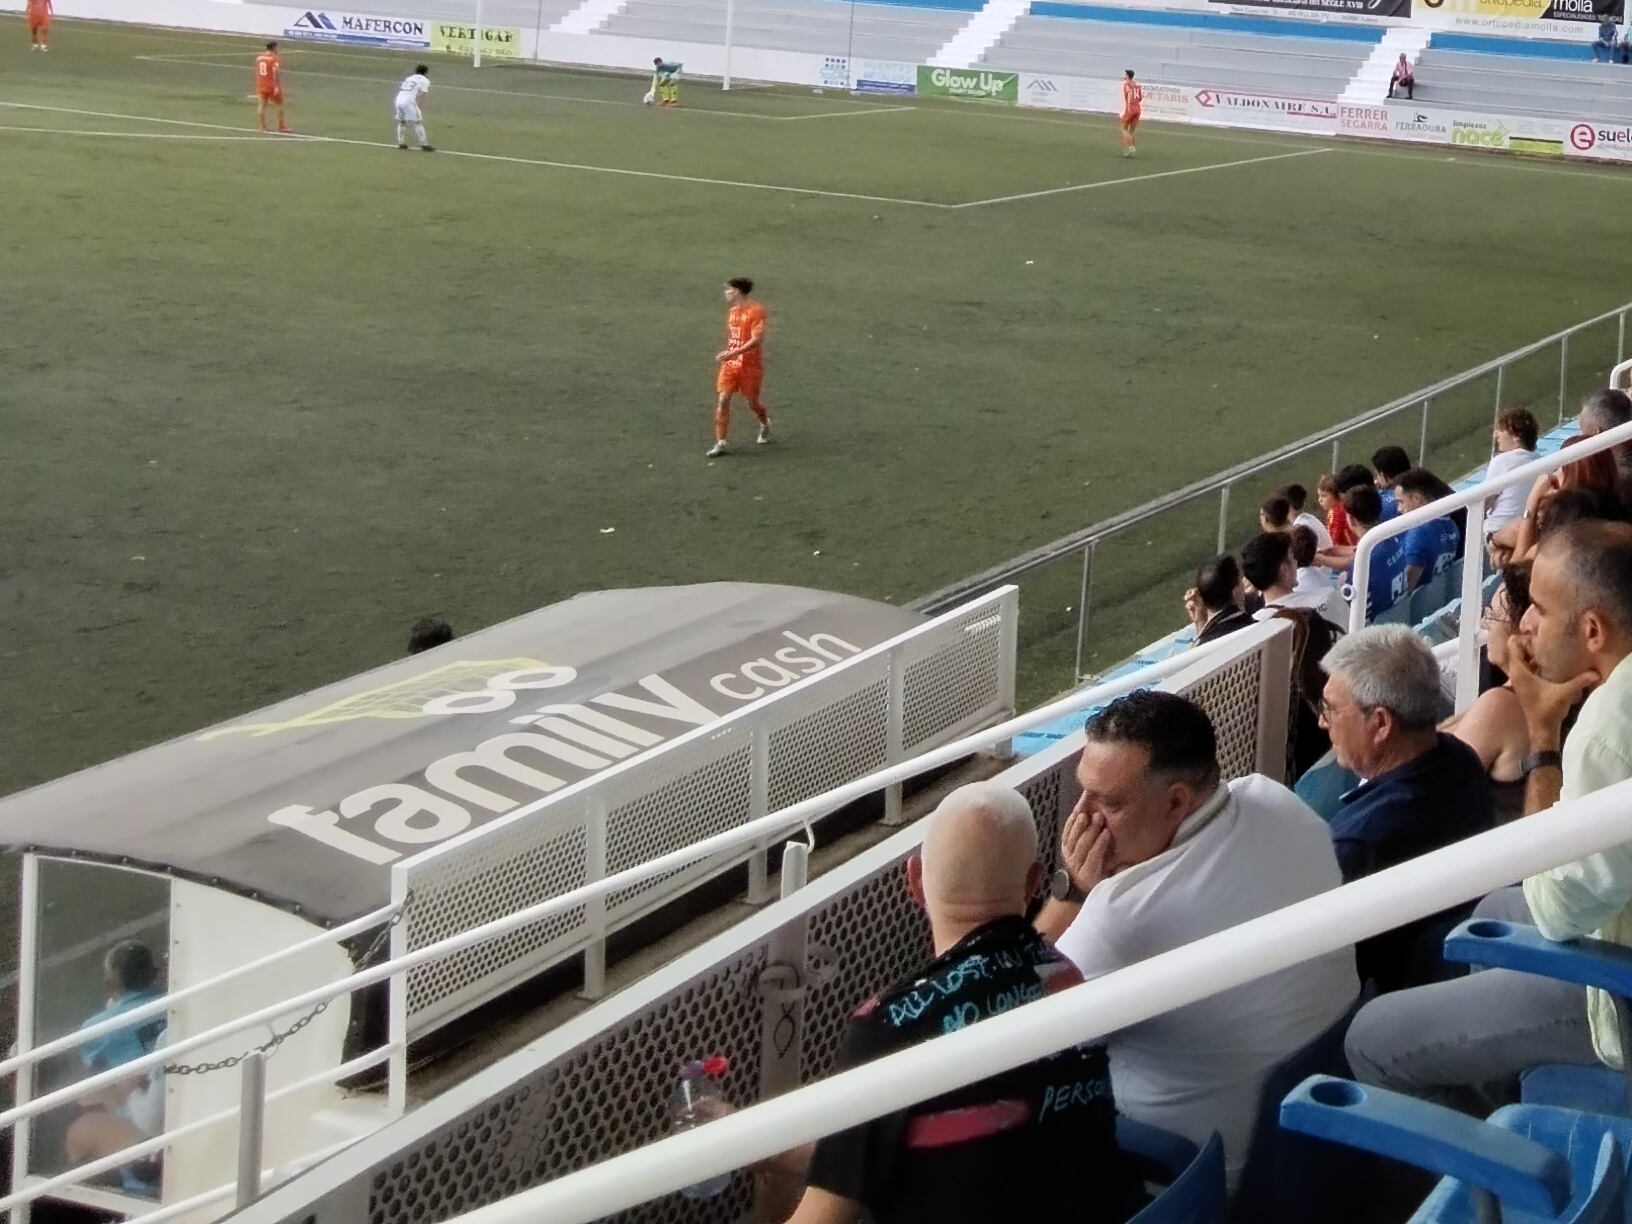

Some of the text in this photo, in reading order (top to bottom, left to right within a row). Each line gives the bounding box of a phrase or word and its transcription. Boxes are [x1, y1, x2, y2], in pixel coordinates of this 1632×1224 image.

[341, 16, 424, 35] MAFERCON
[931, 69, 978, 89] Glow
[980, 73, 1004, 96] Up
[1340, 107, 1388, 121] FERRER
[1341, 119, 1388, 132] SEGARRA
[267, 629, 862, 866] family cash
